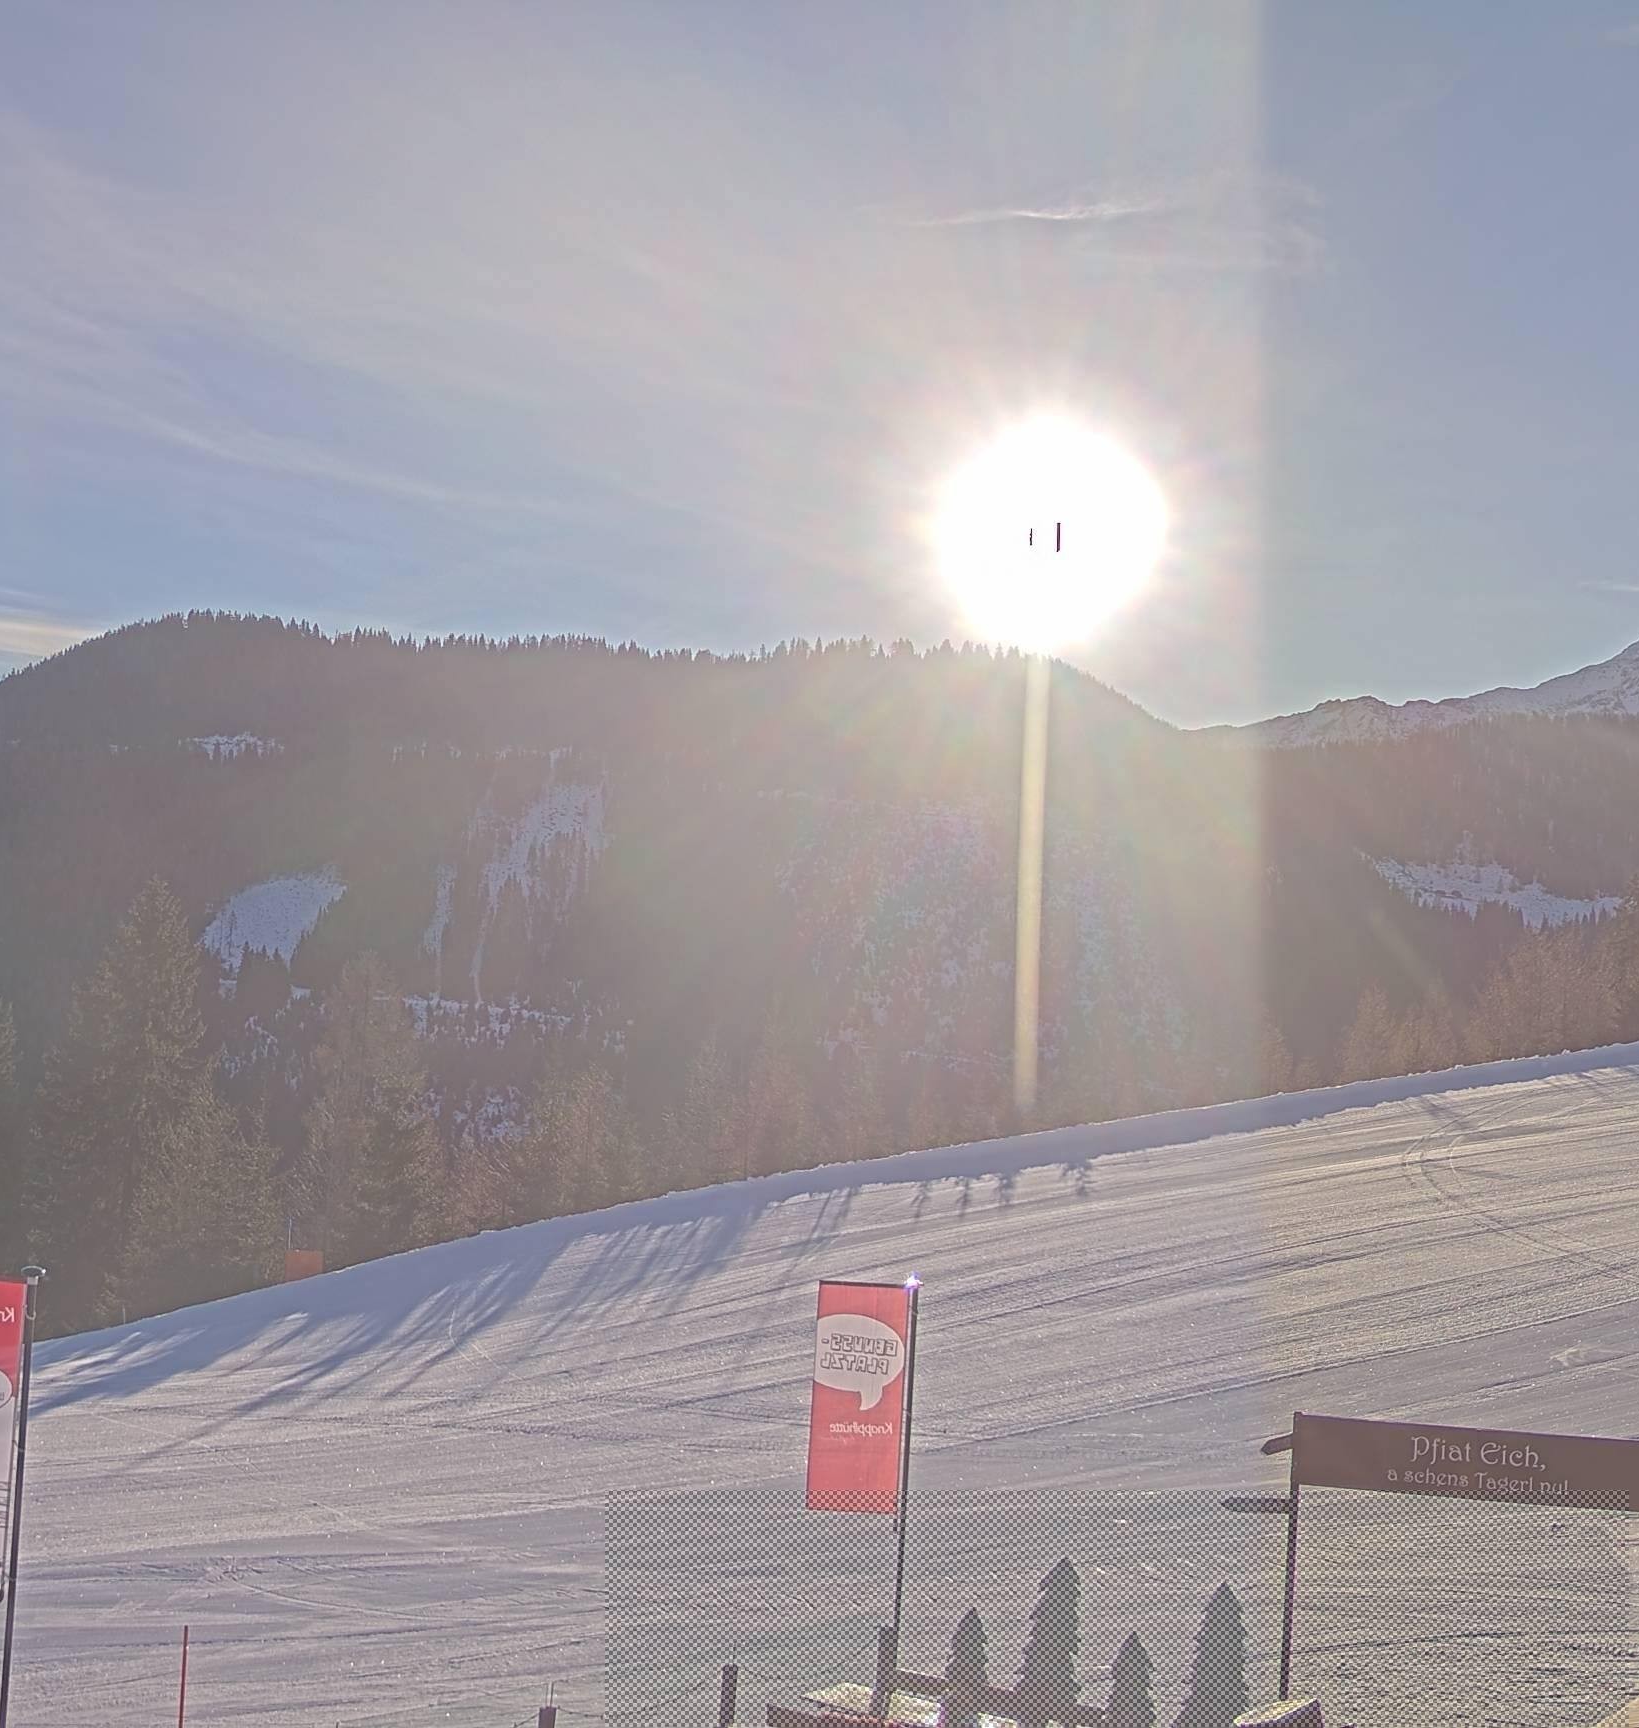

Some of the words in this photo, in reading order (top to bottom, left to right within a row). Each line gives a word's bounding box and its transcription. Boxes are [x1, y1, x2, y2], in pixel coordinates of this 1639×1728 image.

[1410, 1436, 1472, 1465] Pfiat
[1480, 1442, 1547, 1471] Eich,
[1387, 1468, 1398, 1481] a
[1403, 1468, 1469, 1487] schens
[1474, 1471, 1534, 1494] Tagerl
